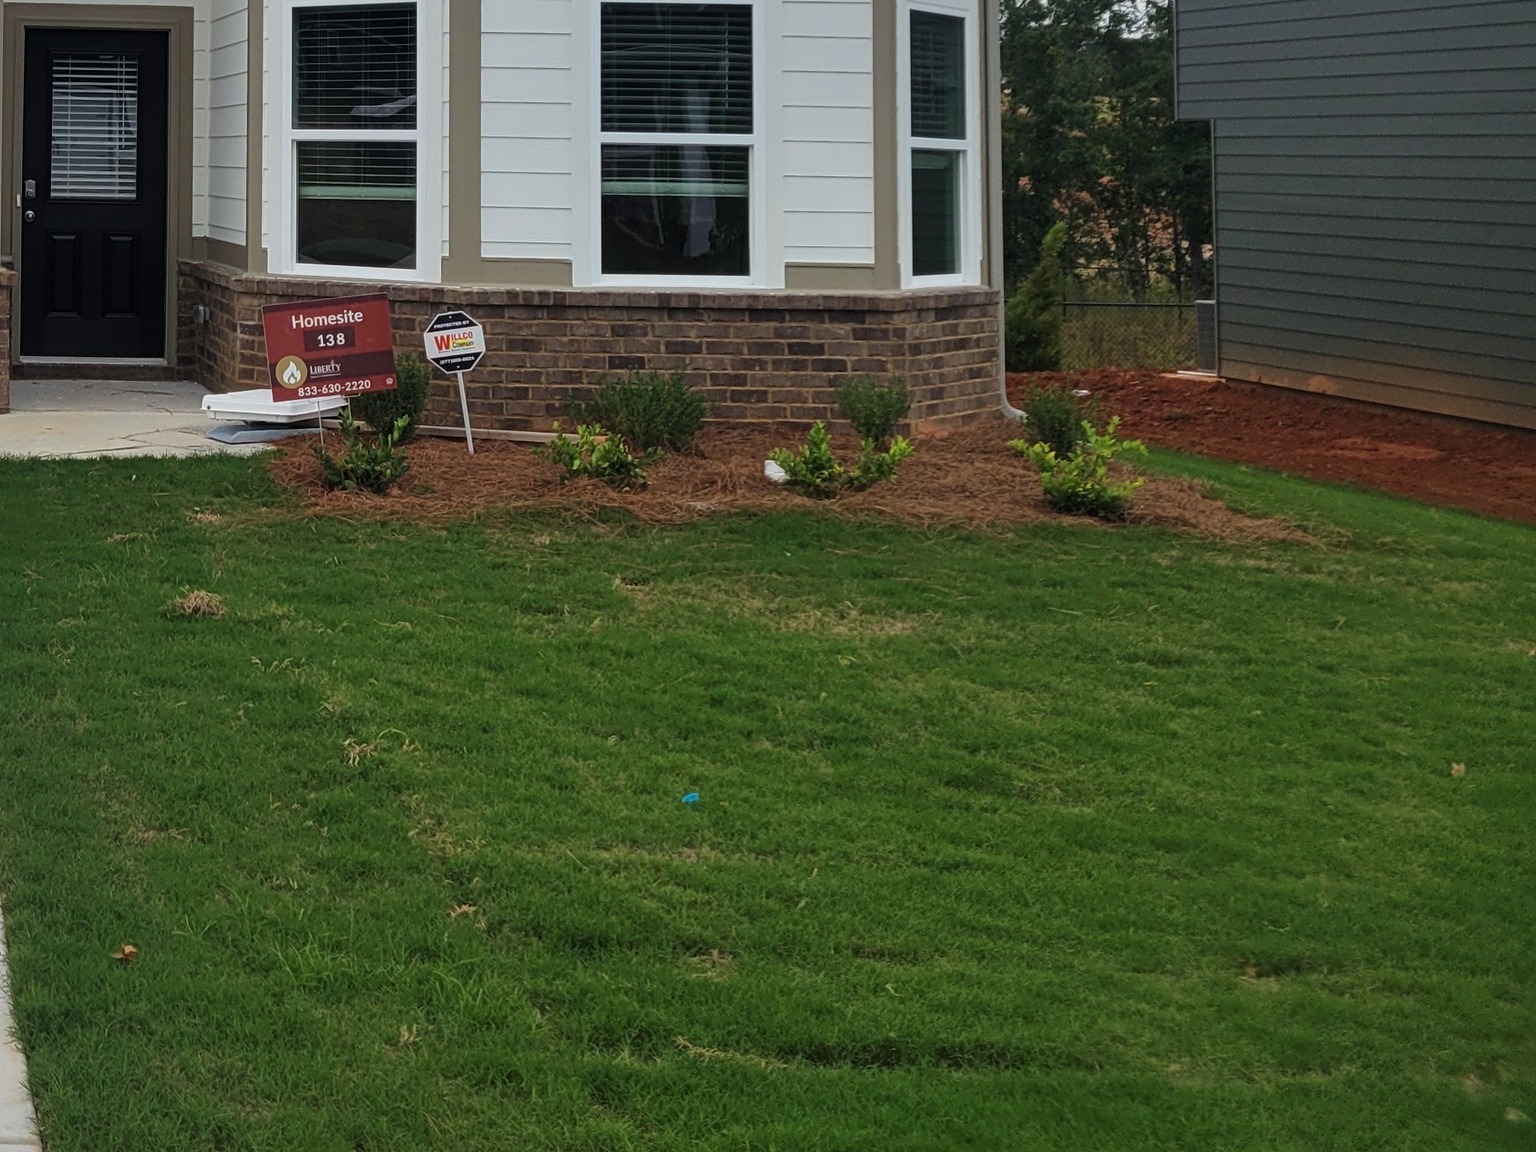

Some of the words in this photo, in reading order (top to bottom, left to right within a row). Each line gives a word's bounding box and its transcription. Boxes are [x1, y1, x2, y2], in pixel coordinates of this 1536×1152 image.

[292, 309, 364, 329] Homesite
[317, 333, 345, 347] 138
[434, 331, 473, 350] WILLCO
[310, 361, 341, 374] LIBERTY
[298, 379, 371, 396] 833-630-2220
